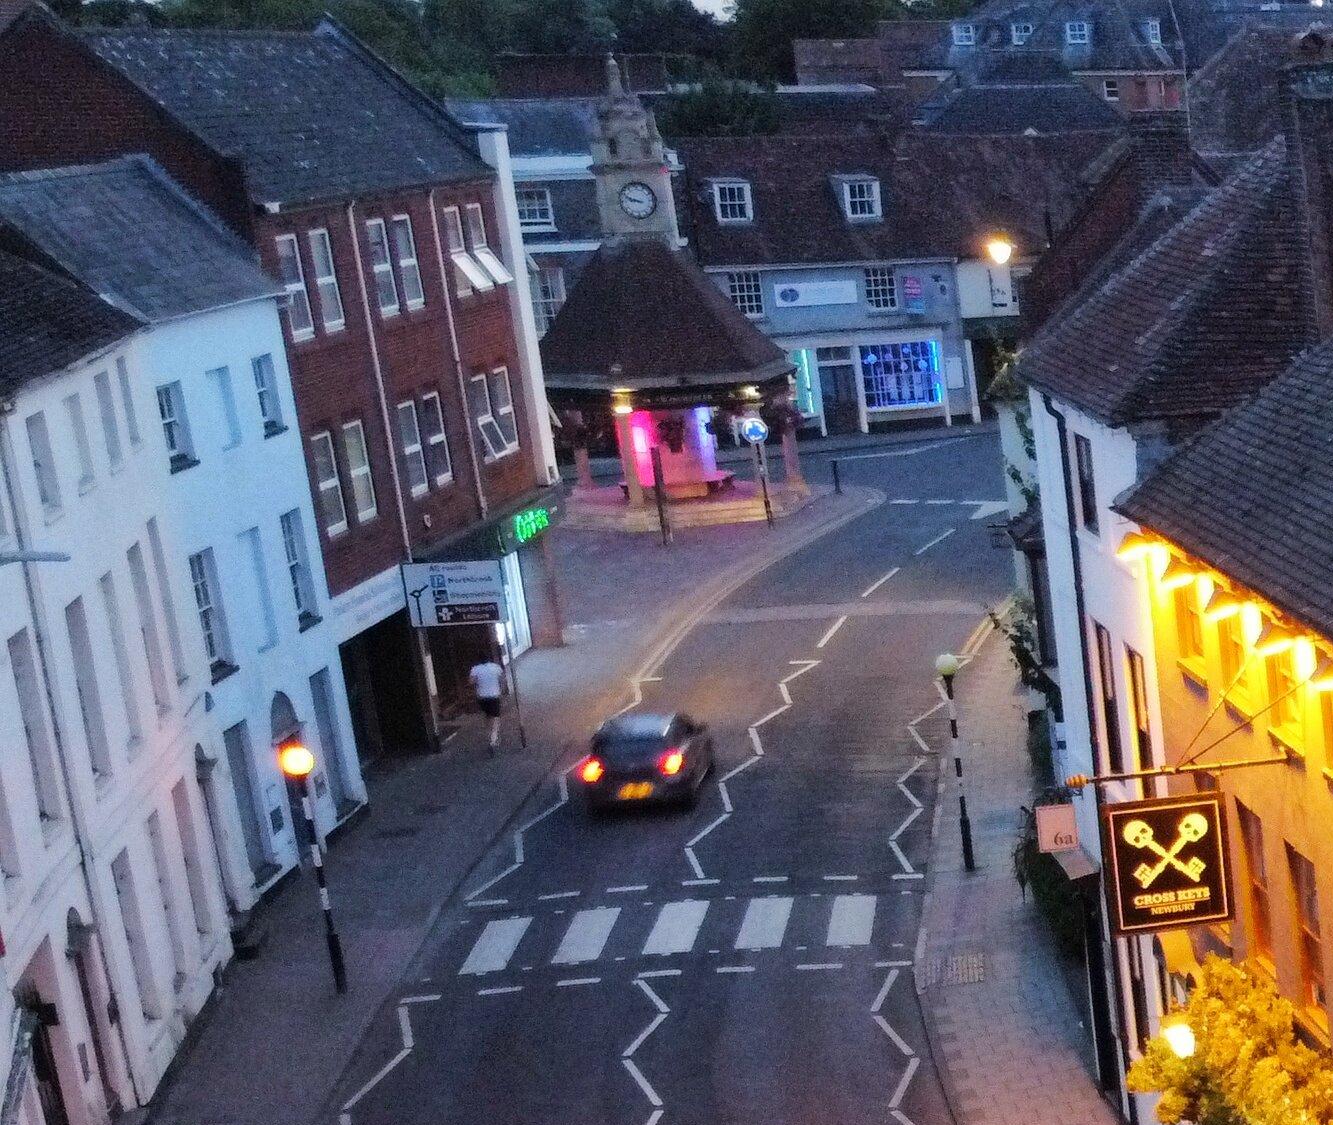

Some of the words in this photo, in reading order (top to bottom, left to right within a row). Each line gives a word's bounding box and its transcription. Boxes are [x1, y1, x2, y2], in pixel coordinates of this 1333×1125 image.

[1134, 890, 1176, 906] CROSS
[1177, 886, 1211, 901] KEYS
[1151, 903, 1195, 915] NEWBURY
